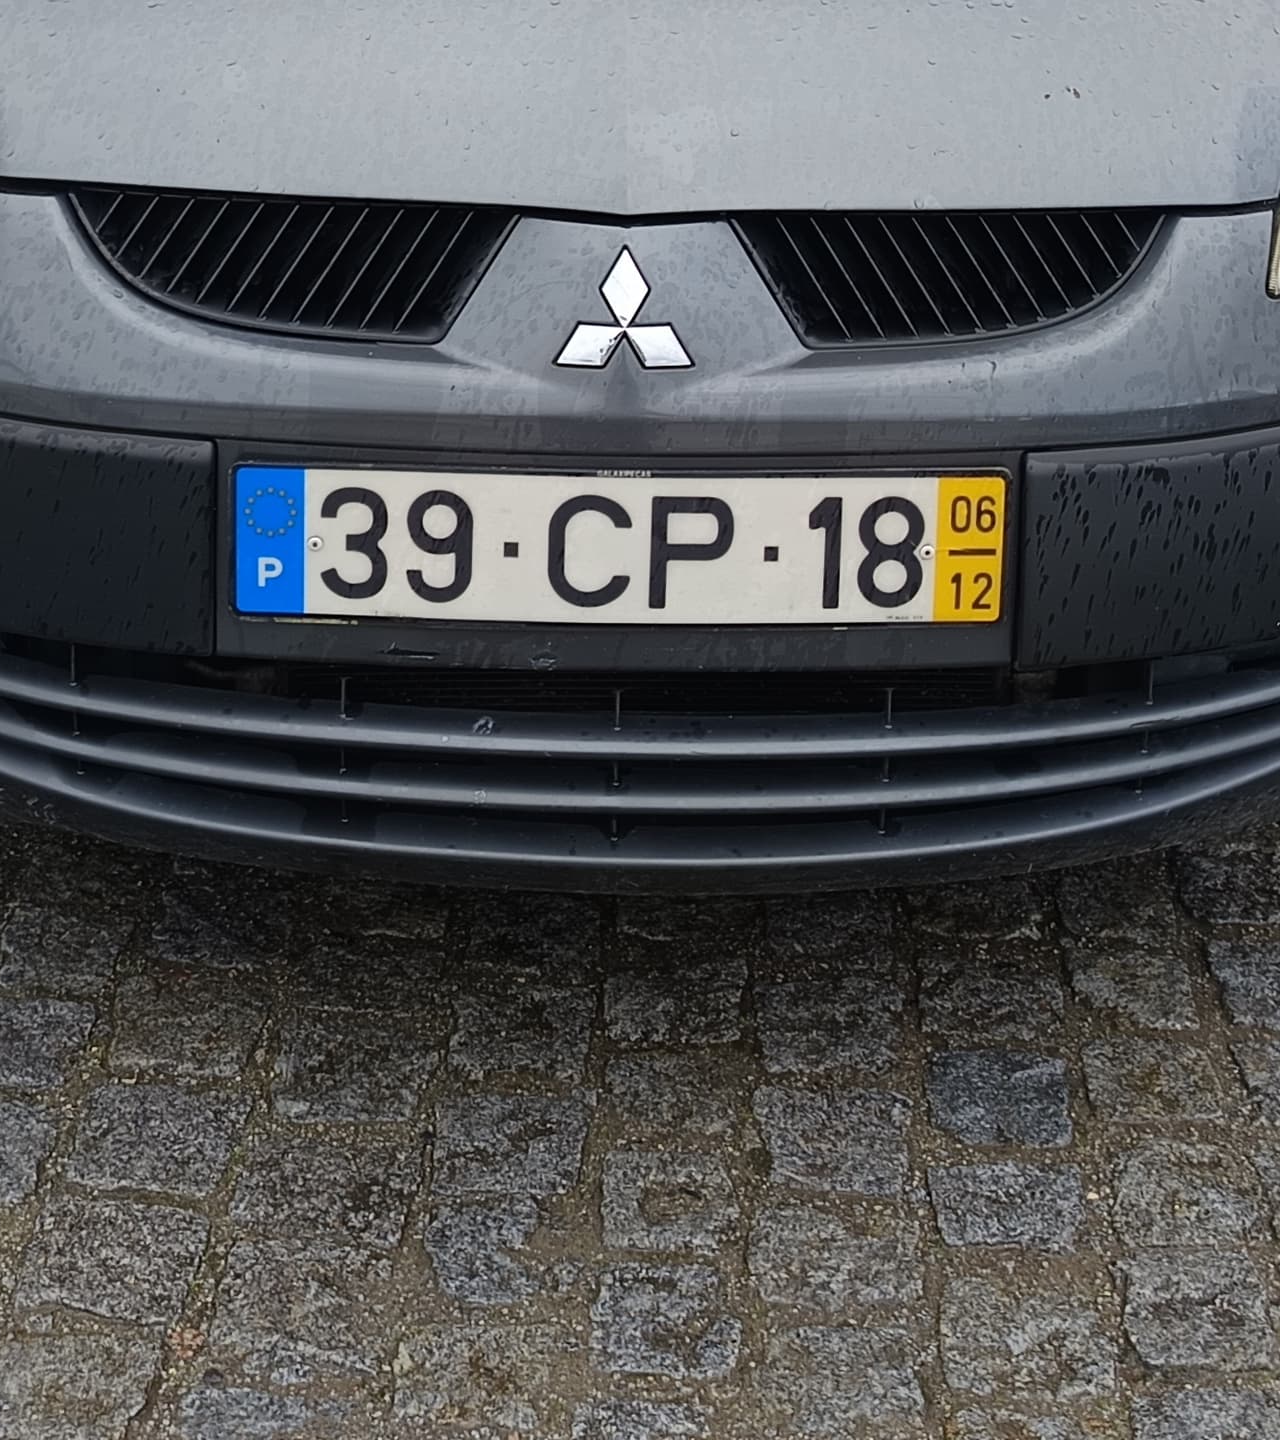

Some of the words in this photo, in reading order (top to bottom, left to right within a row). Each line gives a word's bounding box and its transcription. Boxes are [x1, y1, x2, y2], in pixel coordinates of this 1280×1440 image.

[950, 495, 996, 533] 06
[257, 556, 284, 588] P
[950, 572, 993, 610] 12
